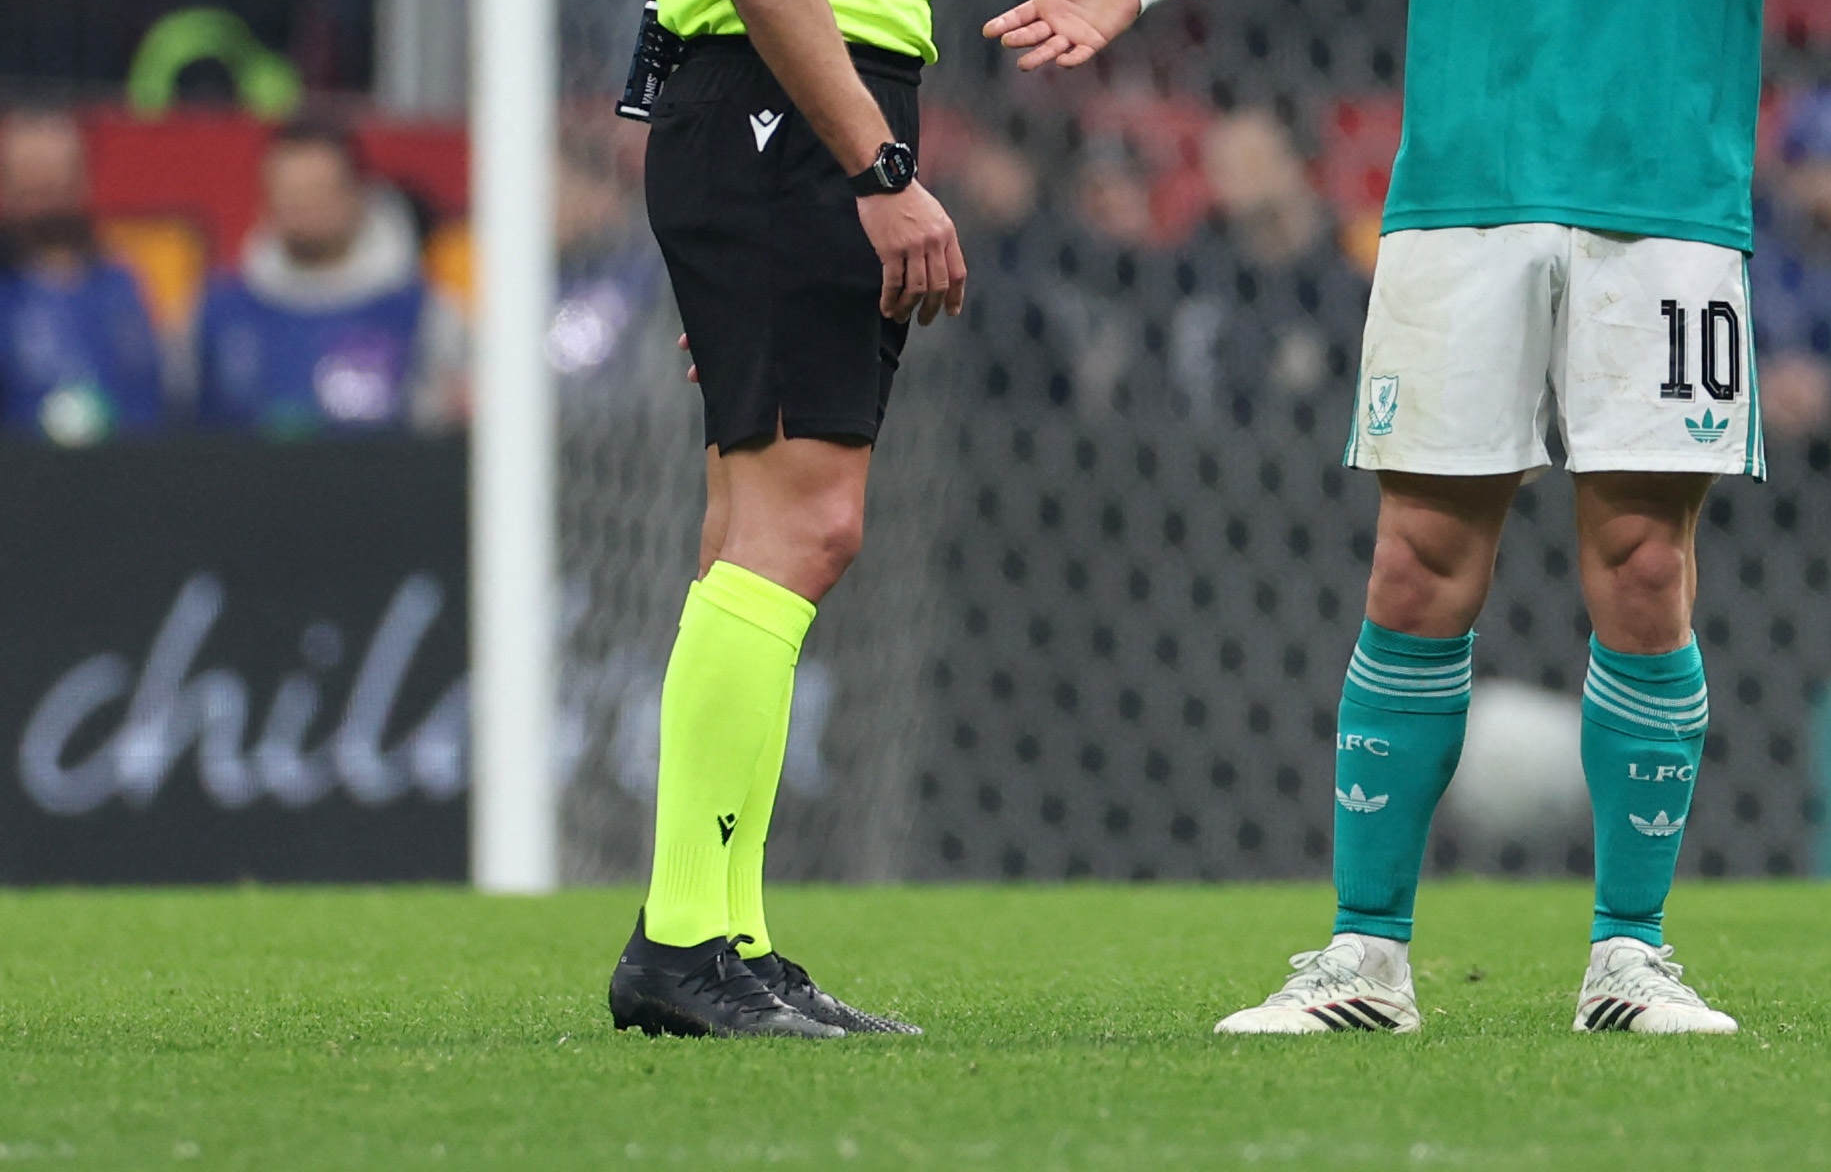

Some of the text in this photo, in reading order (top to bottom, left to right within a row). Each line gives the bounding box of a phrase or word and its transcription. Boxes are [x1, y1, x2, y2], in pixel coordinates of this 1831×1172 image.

[1660, 299, 1742, 402] 10
[1336, 732, 1390, 757] LFC
[1628, 763, 1694, 782] LFC
